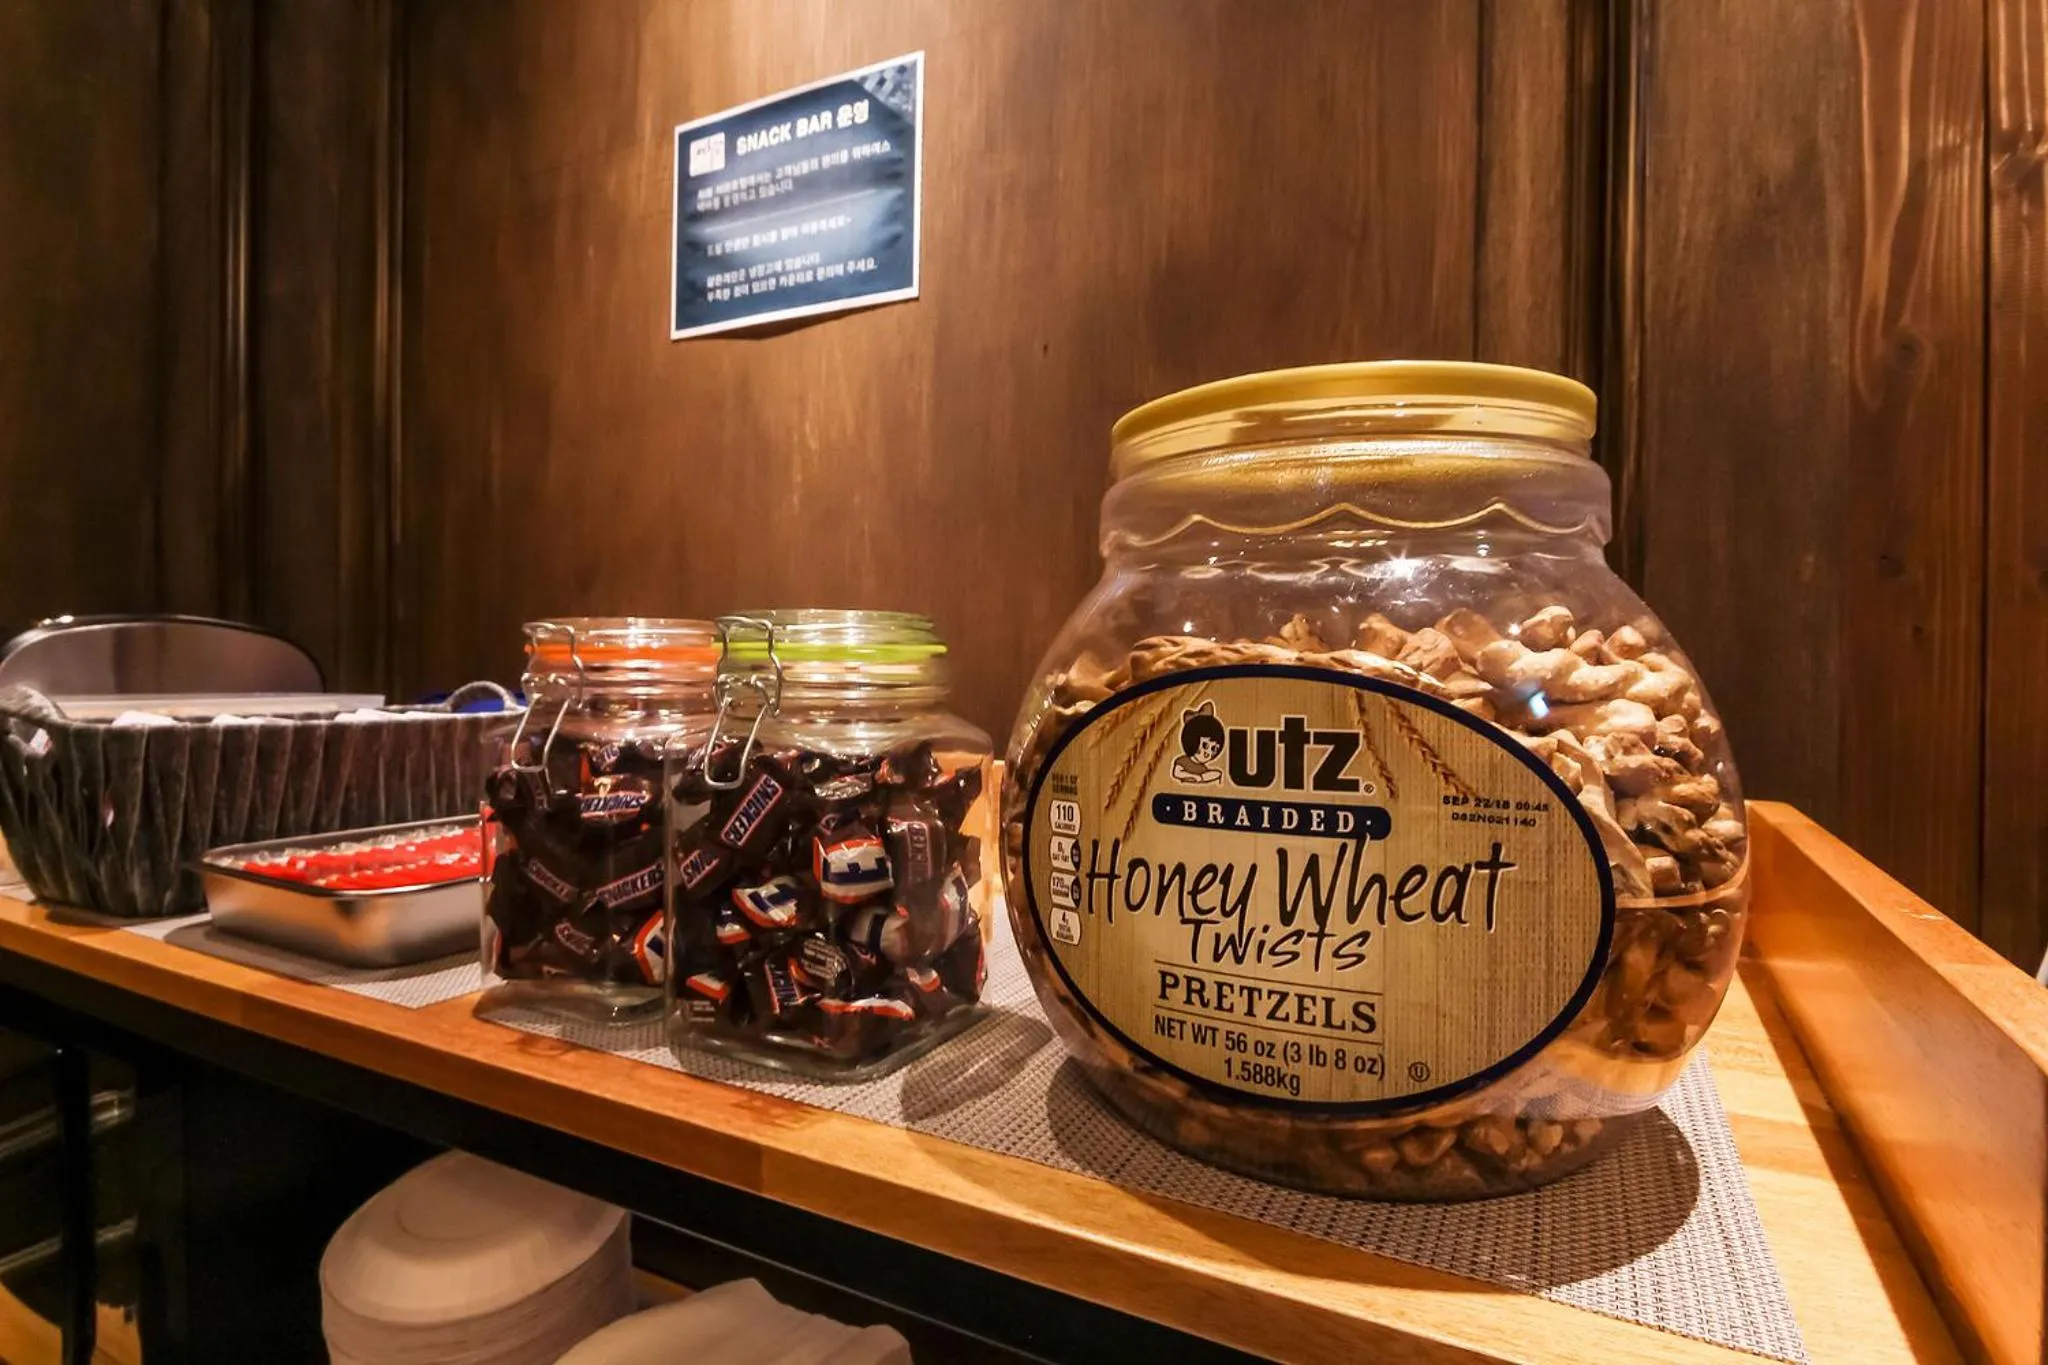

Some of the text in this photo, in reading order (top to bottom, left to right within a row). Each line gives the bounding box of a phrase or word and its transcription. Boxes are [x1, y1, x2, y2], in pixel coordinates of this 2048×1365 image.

[736, 122, 792, 156] SNACK
[796, 110, 833, 138] BAR
[836, 99, 870, 129] 운영
[1228, 716, 1361, 793] utz
[1056, 804, 1074, 822] 110
[1182, 799, 1355, 834] BRAIDED
[1442, 795, 1469, 806] SEP
[1085, 832, 1517, 947] Honey Wheat
[1180, 917, 1371, 972] Twists
[1157, 970, 1378, 1034] PRETZELS
[1154, 1014, 1386, 1081] NET WT 56 oz (3 lb 8 oz)
[1223, 1056, 1301, 1097] 1.588kg
